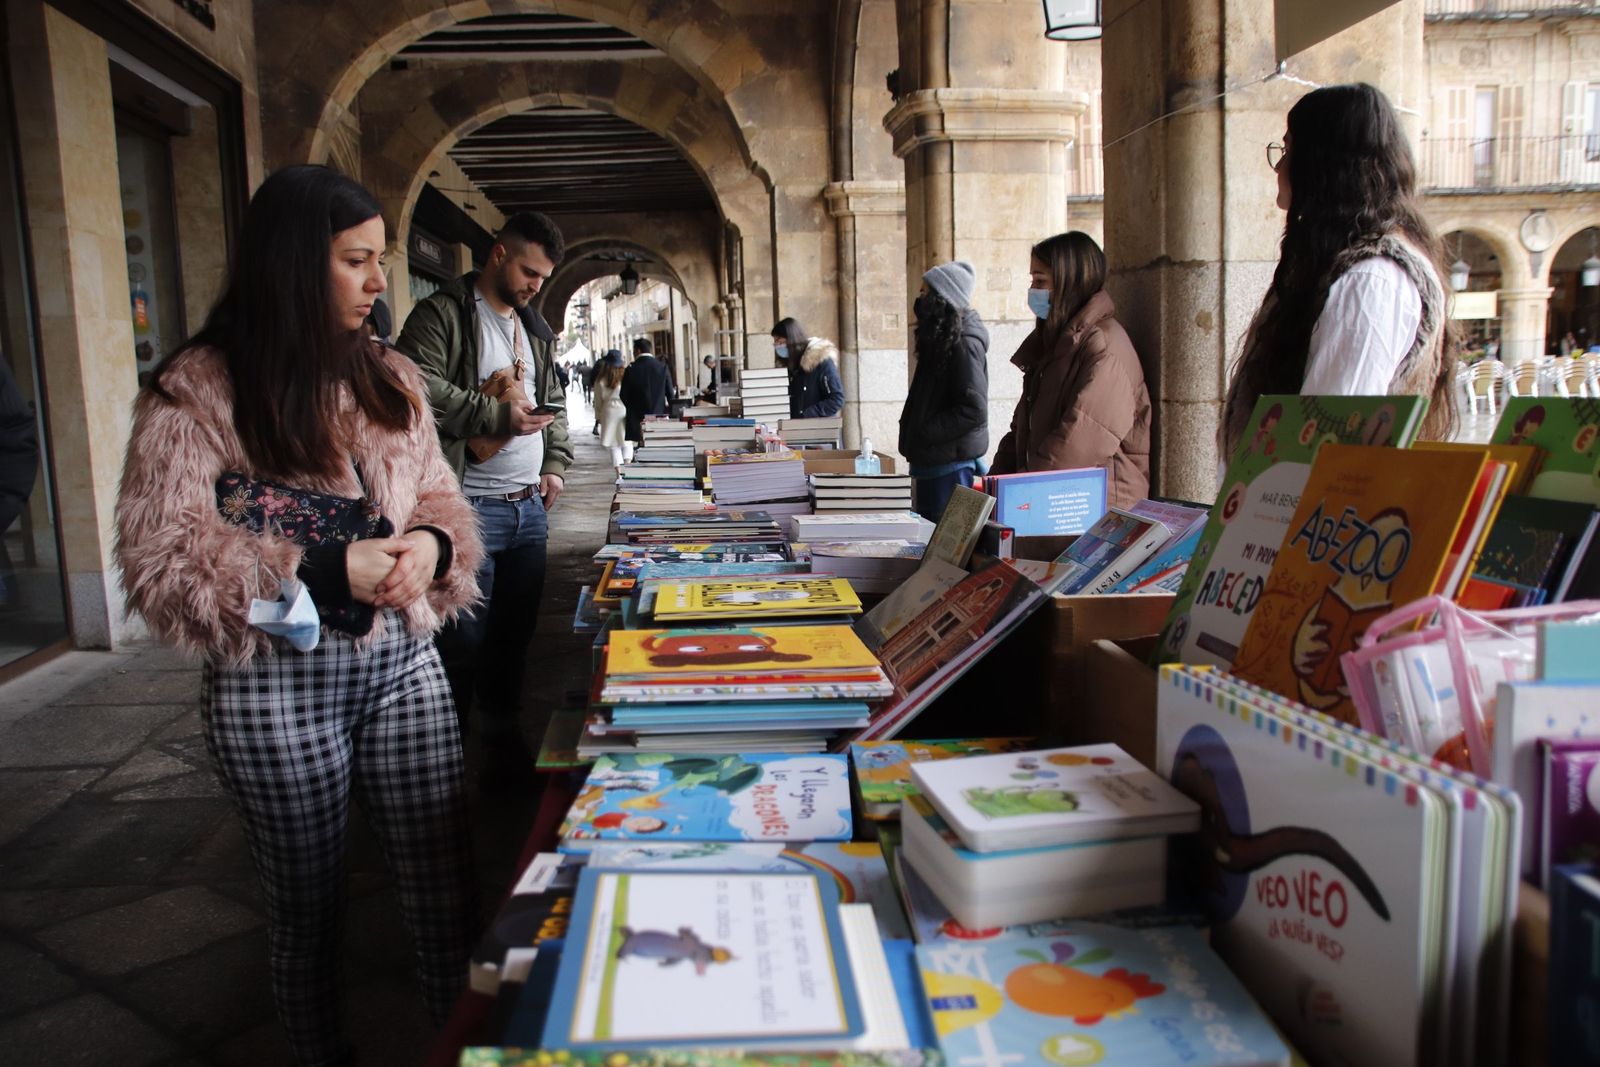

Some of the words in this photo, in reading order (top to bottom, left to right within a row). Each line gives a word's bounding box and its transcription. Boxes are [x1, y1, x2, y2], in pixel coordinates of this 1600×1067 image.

[1243, 543, 1254, 560] MI
[1289, 498, 1412, 582] ABEZOO
[1091, 571, 1121, 595] BEST
[1196, 567, 1264, 616] ABECED
[752, 784, 790, 837] DRAGONES
[789, 779, 829, 820] llegaron
[1256, 875, 1289, 909] VEO
[1293, 869, 1348, 928] VEO
